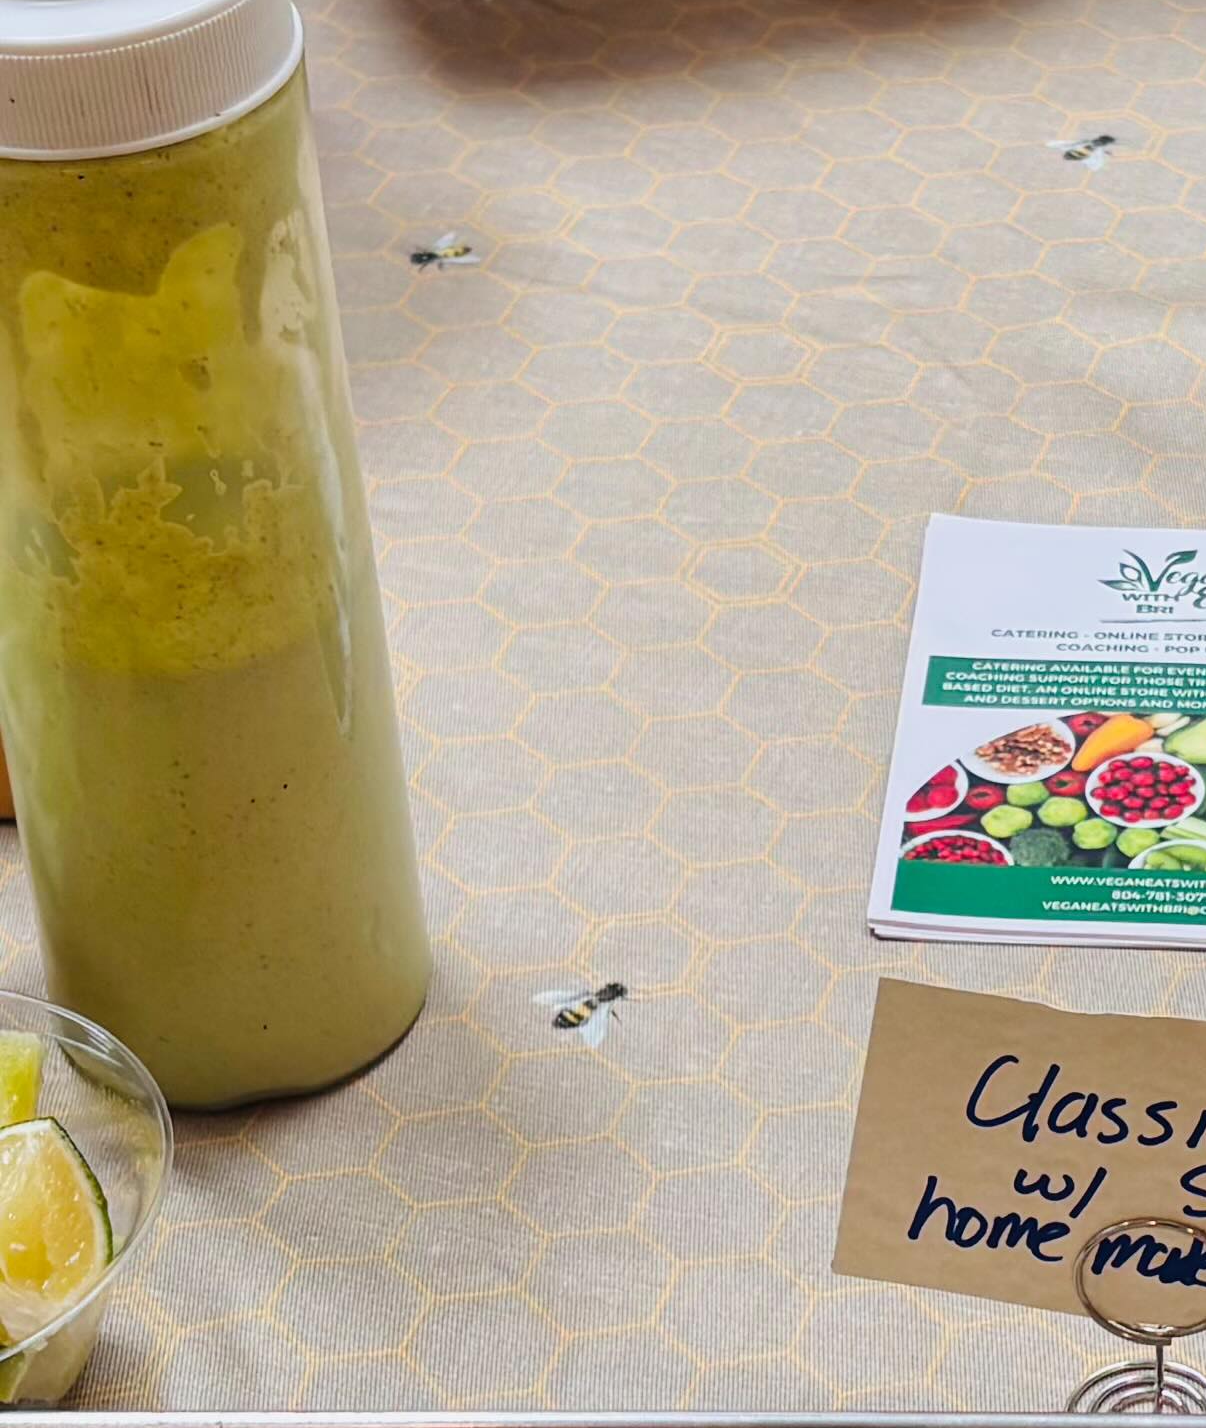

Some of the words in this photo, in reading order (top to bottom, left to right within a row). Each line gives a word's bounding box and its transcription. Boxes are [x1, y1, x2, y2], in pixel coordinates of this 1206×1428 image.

[1122, 593, 1180, 602] WITH
[1136, 604, 1174, 614] BRI
[991, 629, 1078, 639] CATERING
[1094, 632, 1159, 641] ONLINE
[1056, 643, 1149, 652] COACHING
[1164, 645, 1200, 654] POP
[972, 662, 1046, 671] CATERING
[1050, 664, 1130, 673] AVAILABLE
[1134, 665, 1163, 674] FOR
[945, 672, 1025, 682] COACHING
[1028, 673, 1097, 684] SUPPORT
[1102, 675, 1131, 685] FOR
[1136, 677, 1184, 687] THOSE
[942, 682, 992, 692] BASED
[1036, 685, 1058, 694] AN
[1061, 686, 1116, 695] ONLINE
[1120, 687, 1168, 697] STORE
[963, 694, 998, 704] AND
[1002, 695, 1067, 705] DESSERT
[1070, 697, 1137, 707] OPTIONS
[1140, 699, 1174, 709] AND
[1013, 1166, 1107, 1219] w/
[907, 1175, 1072, 1262] home
